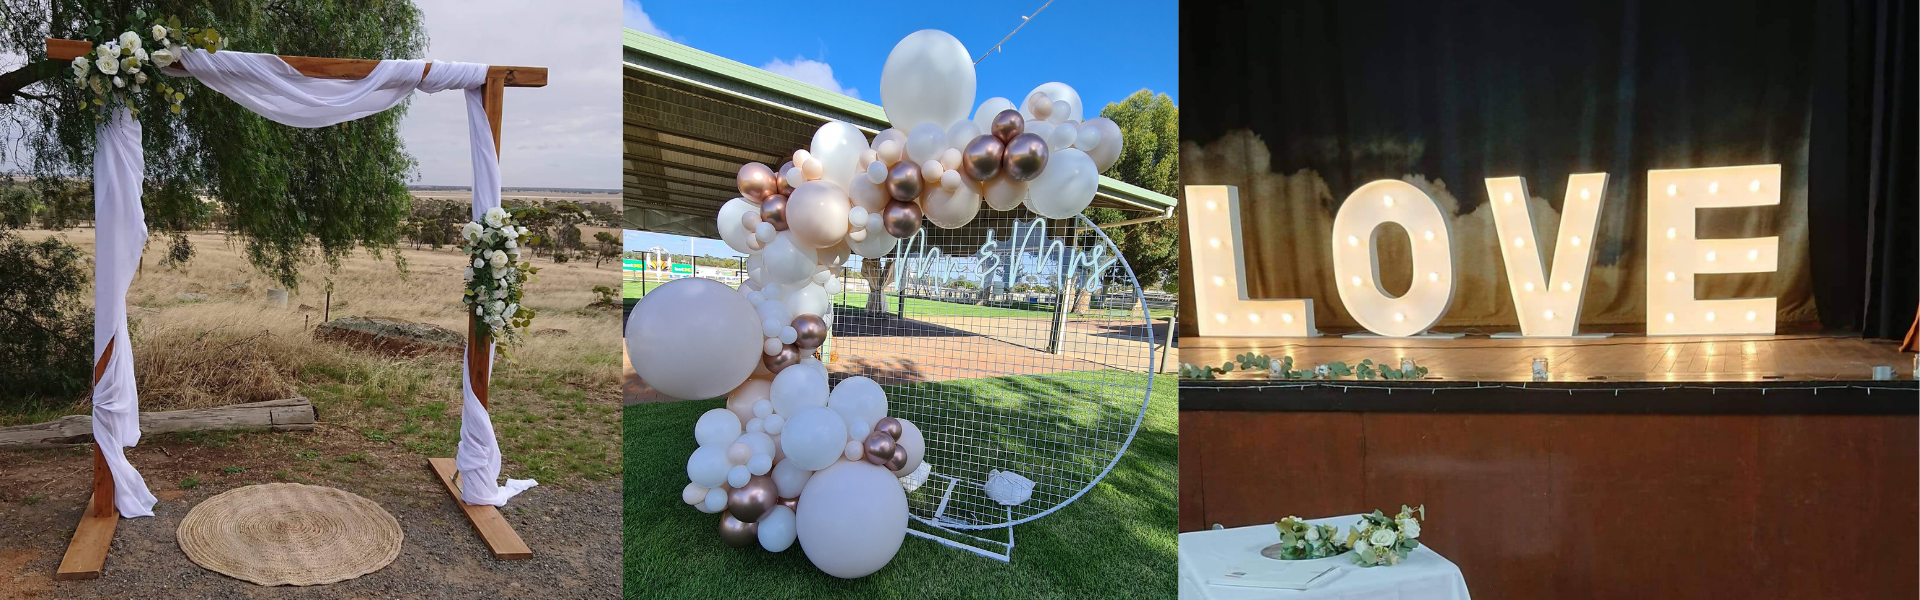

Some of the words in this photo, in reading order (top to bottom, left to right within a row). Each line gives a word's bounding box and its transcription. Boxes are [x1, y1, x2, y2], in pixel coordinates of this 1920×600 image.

[895, 227, 967, 294] Mr
[974, 229, 1000, 289] &
[1009, 217, 1118, 292] Mrs
[1184, 163, 1781, 337] LOVE
